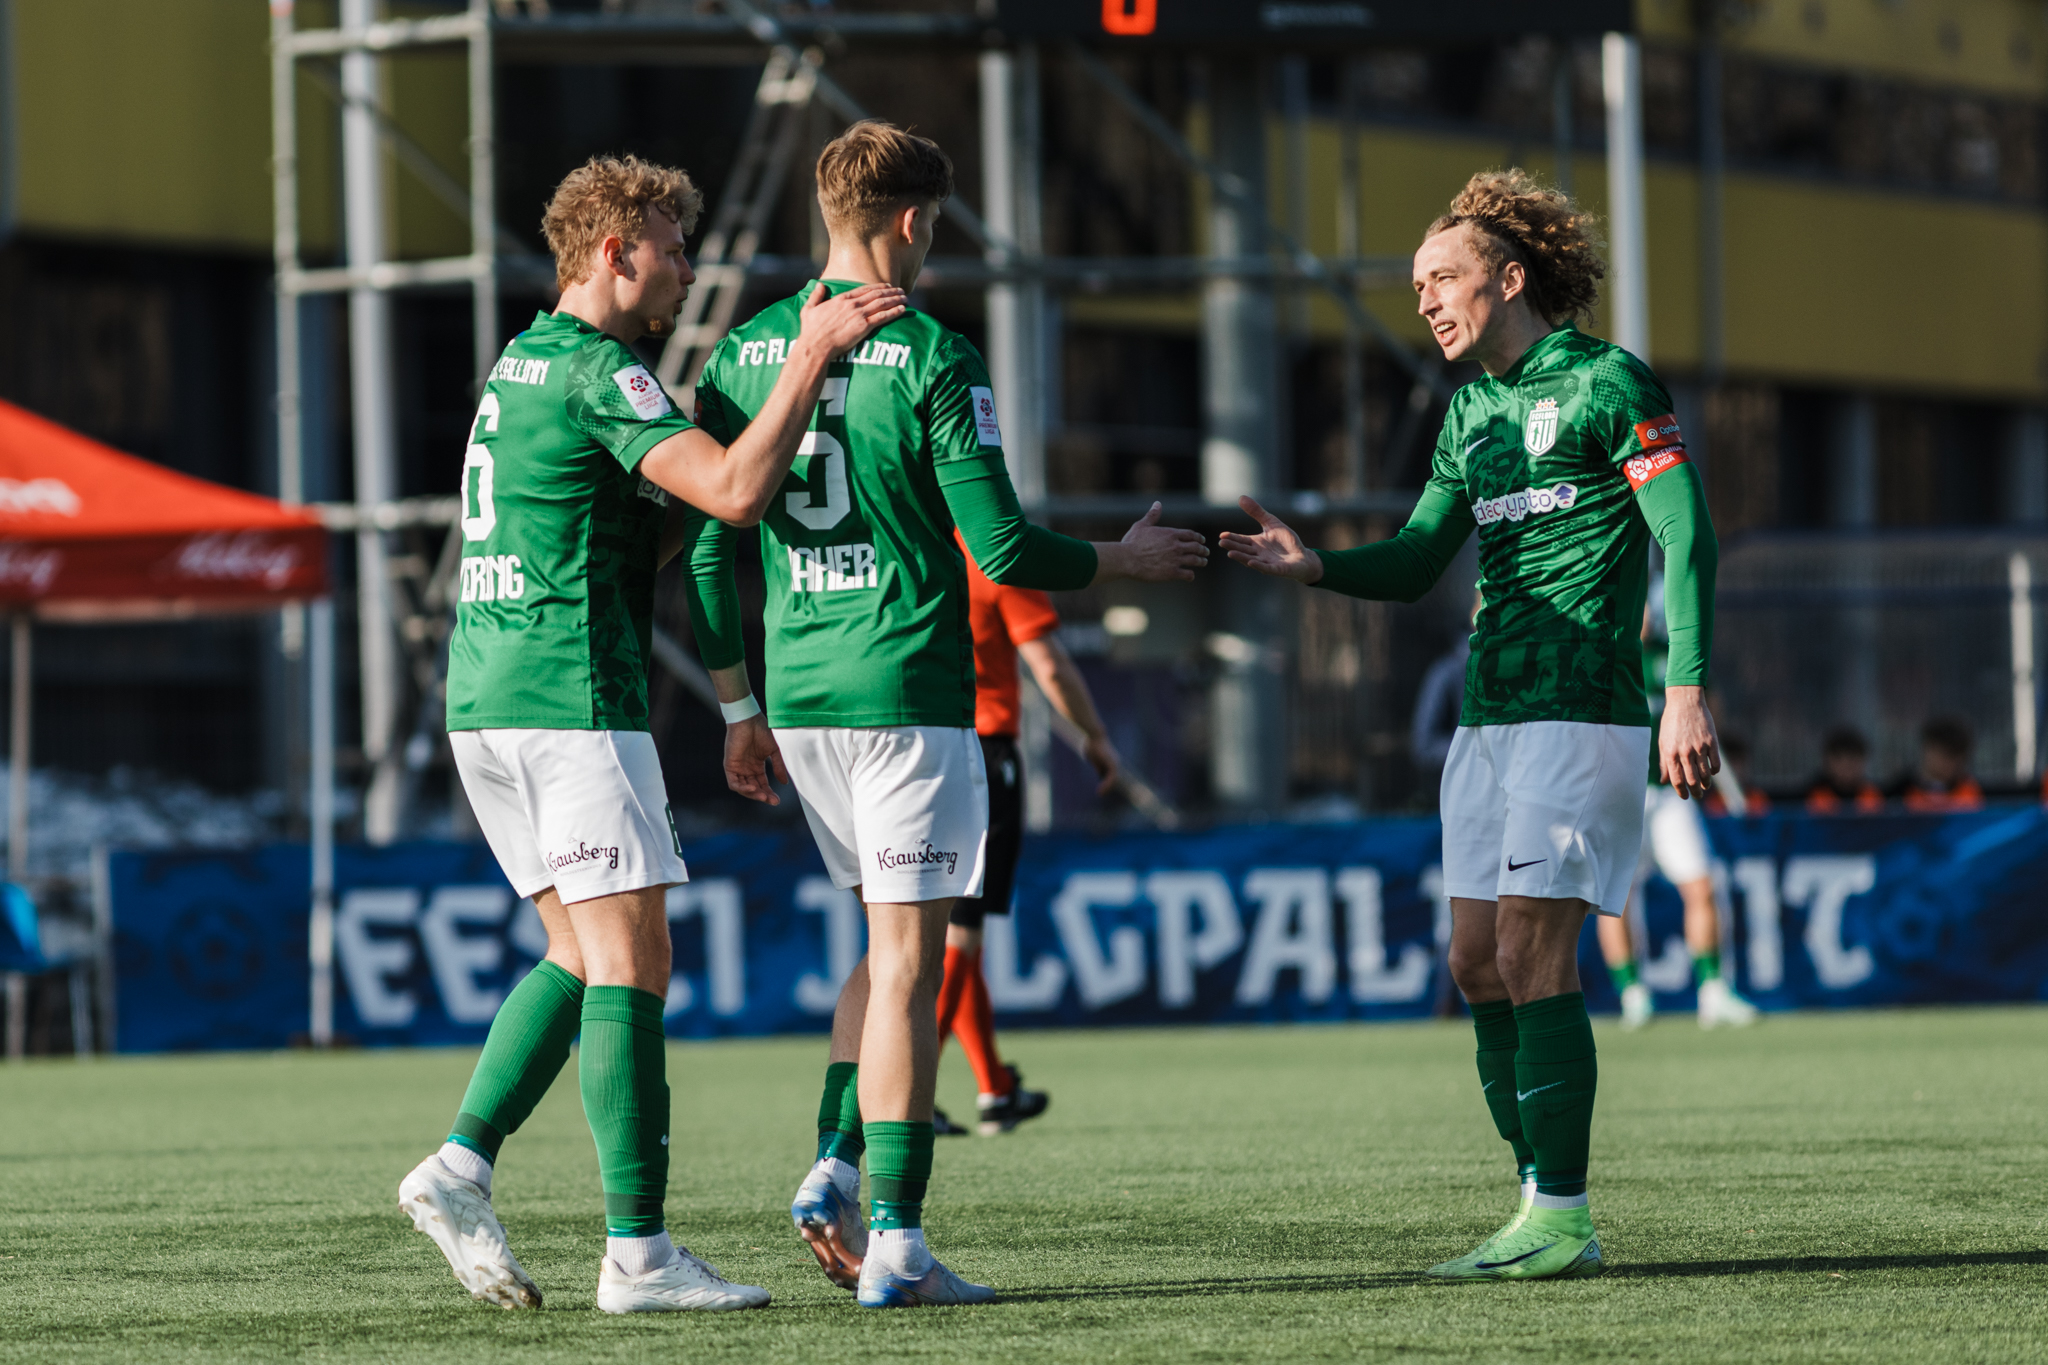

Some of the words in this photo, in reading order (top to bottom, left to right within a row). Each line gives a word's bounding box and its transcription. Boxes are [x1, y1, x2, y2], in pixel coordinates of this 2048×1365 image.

[738, 341, 766, 367] FC
[461, 393, 500, 541] 6
[786, 377, 850, 530] 5
[1653, 454, 1676, 469] LIIGA
[546, 841, 618, 876] Krausberg
[877, 843, 958, 875] Krausberg
